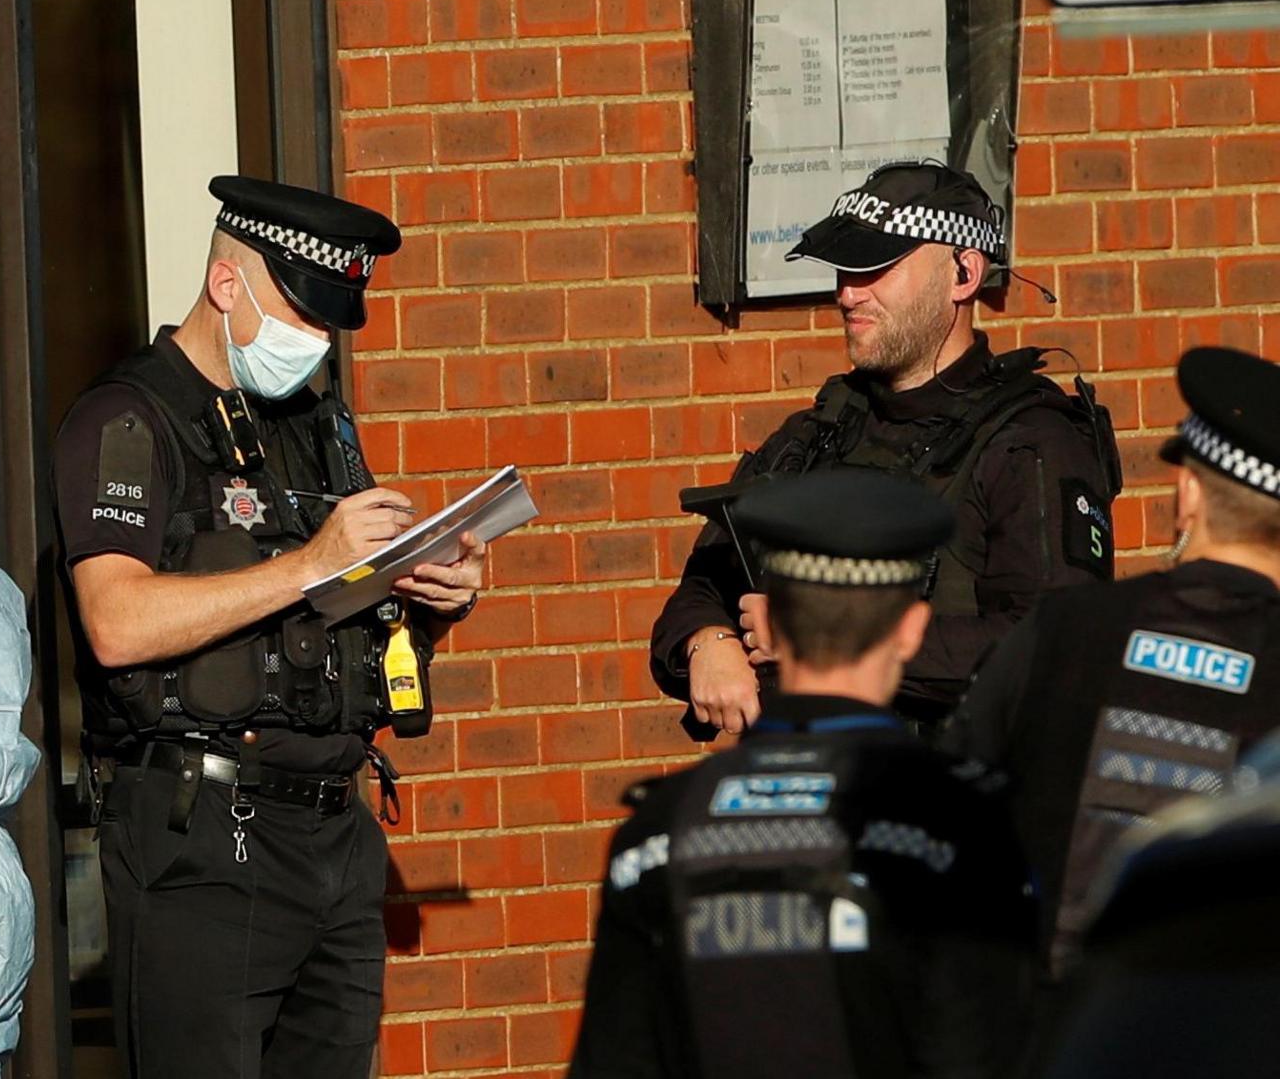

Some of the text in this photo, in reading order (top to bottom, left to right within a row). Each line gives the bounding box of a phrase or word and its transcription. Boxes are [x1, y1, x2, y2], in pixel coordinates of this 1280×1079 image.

[761, 163, 779, 176] other
[780, 160, 805, 177] special
[832, 191, 890, 225] POLICE
[106, 481, 143, 500] 2816
[92, 507, 146, 528] POLICE
[1090, 524, 1103, 559] 5
[1132, 636, 1246, 686] POLICE
[685, 892, 826, 956] POLIC
